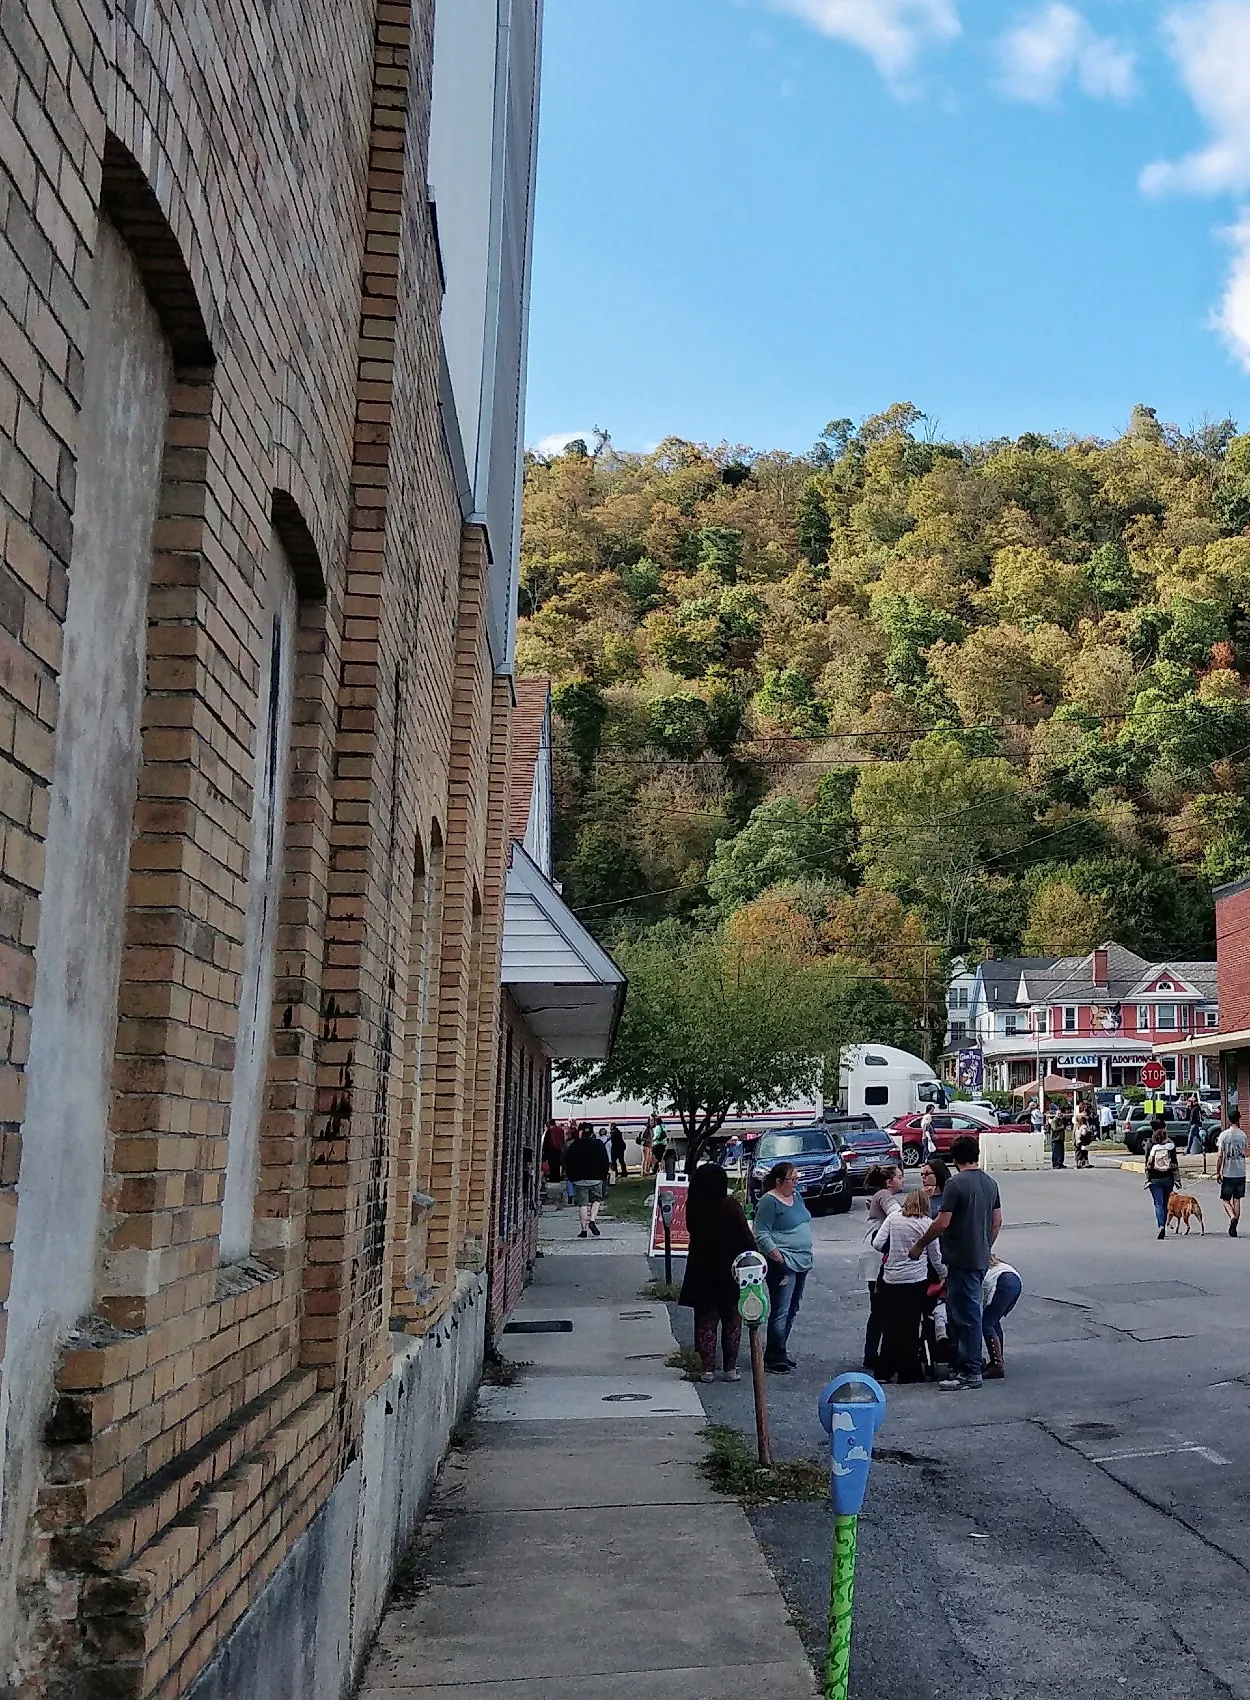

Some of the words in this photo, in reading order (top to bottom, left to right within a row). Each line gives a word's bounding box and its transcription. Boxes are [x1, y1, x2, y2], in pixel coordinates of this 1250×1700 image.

[1057, 1055, 1075, 1065] CAT
[1075, 1053, 1098, 1065] CAFÉ
[1141, 1069, 1166, 1081] STOP
